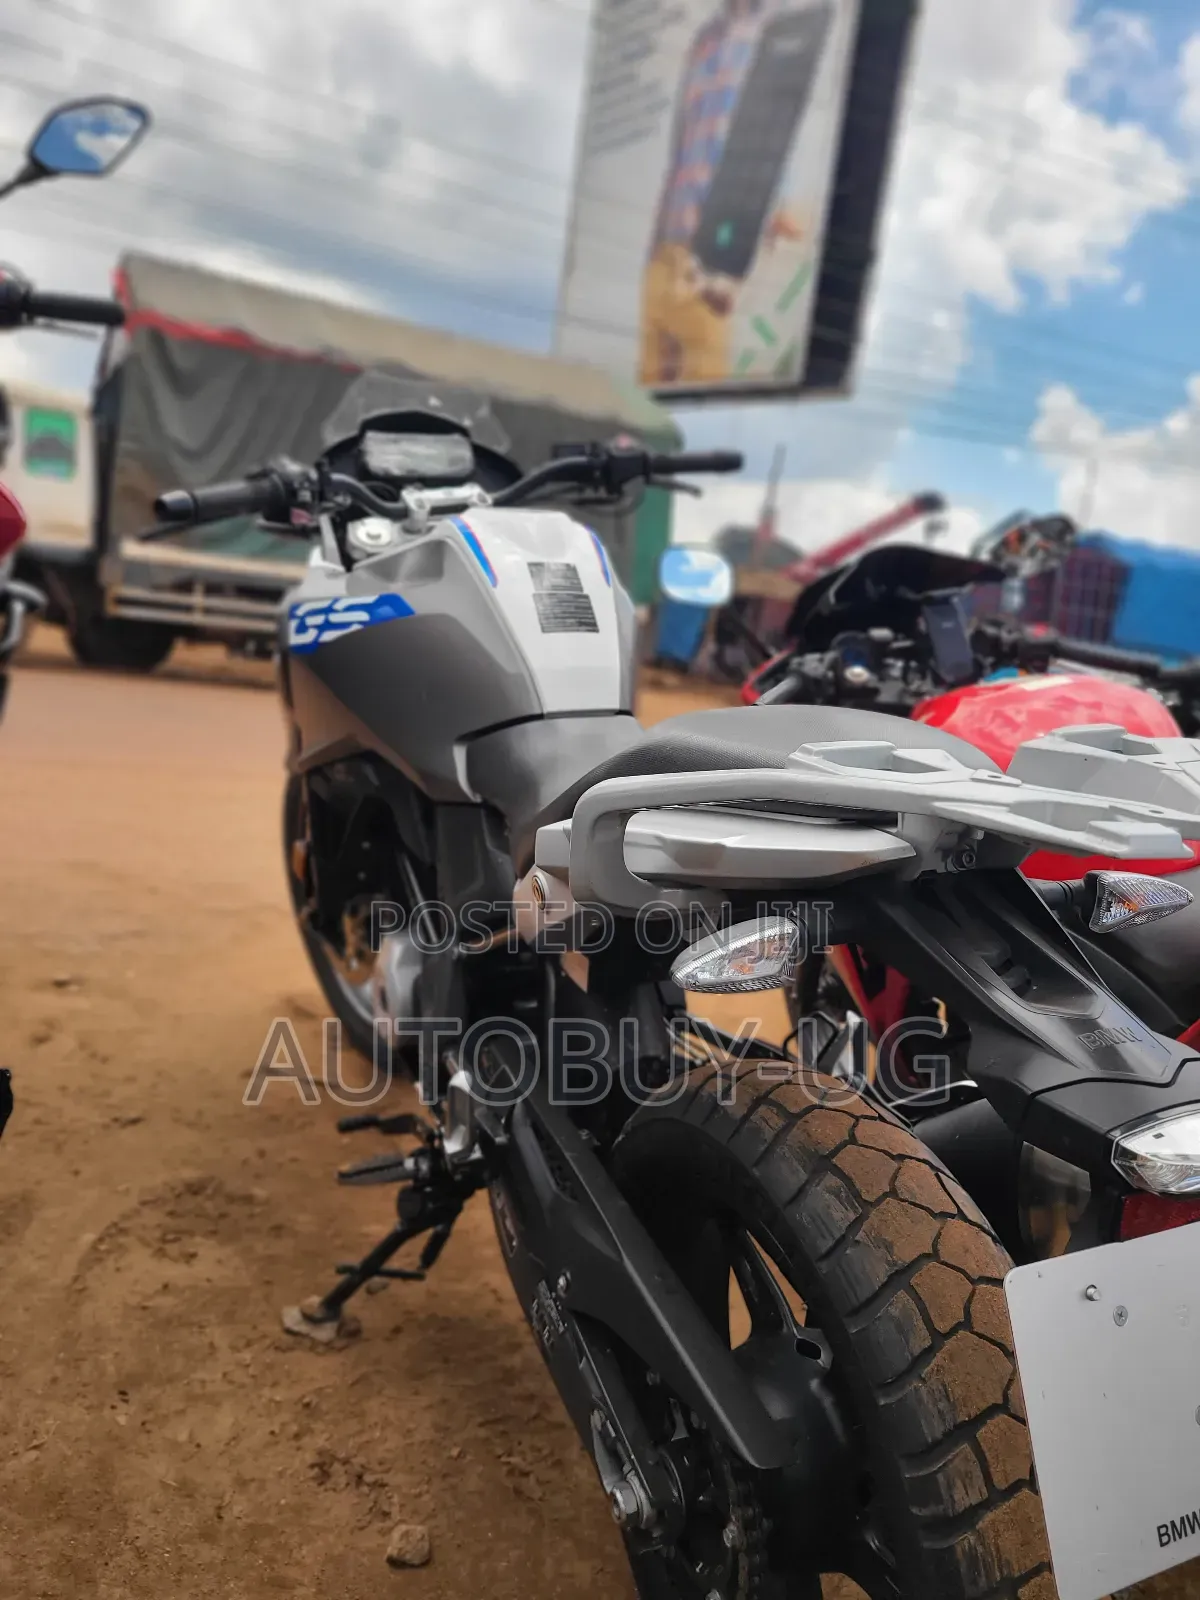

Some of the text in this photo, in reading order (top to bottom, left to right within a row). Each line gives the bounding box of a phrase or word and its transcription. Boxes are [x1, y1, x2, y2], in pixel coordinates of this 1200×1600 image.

[289, 595, 378, 646] GS
[1076, 1027, 1143, 1051] BMW
[1157, 1508, 1200, 1547] BMW
